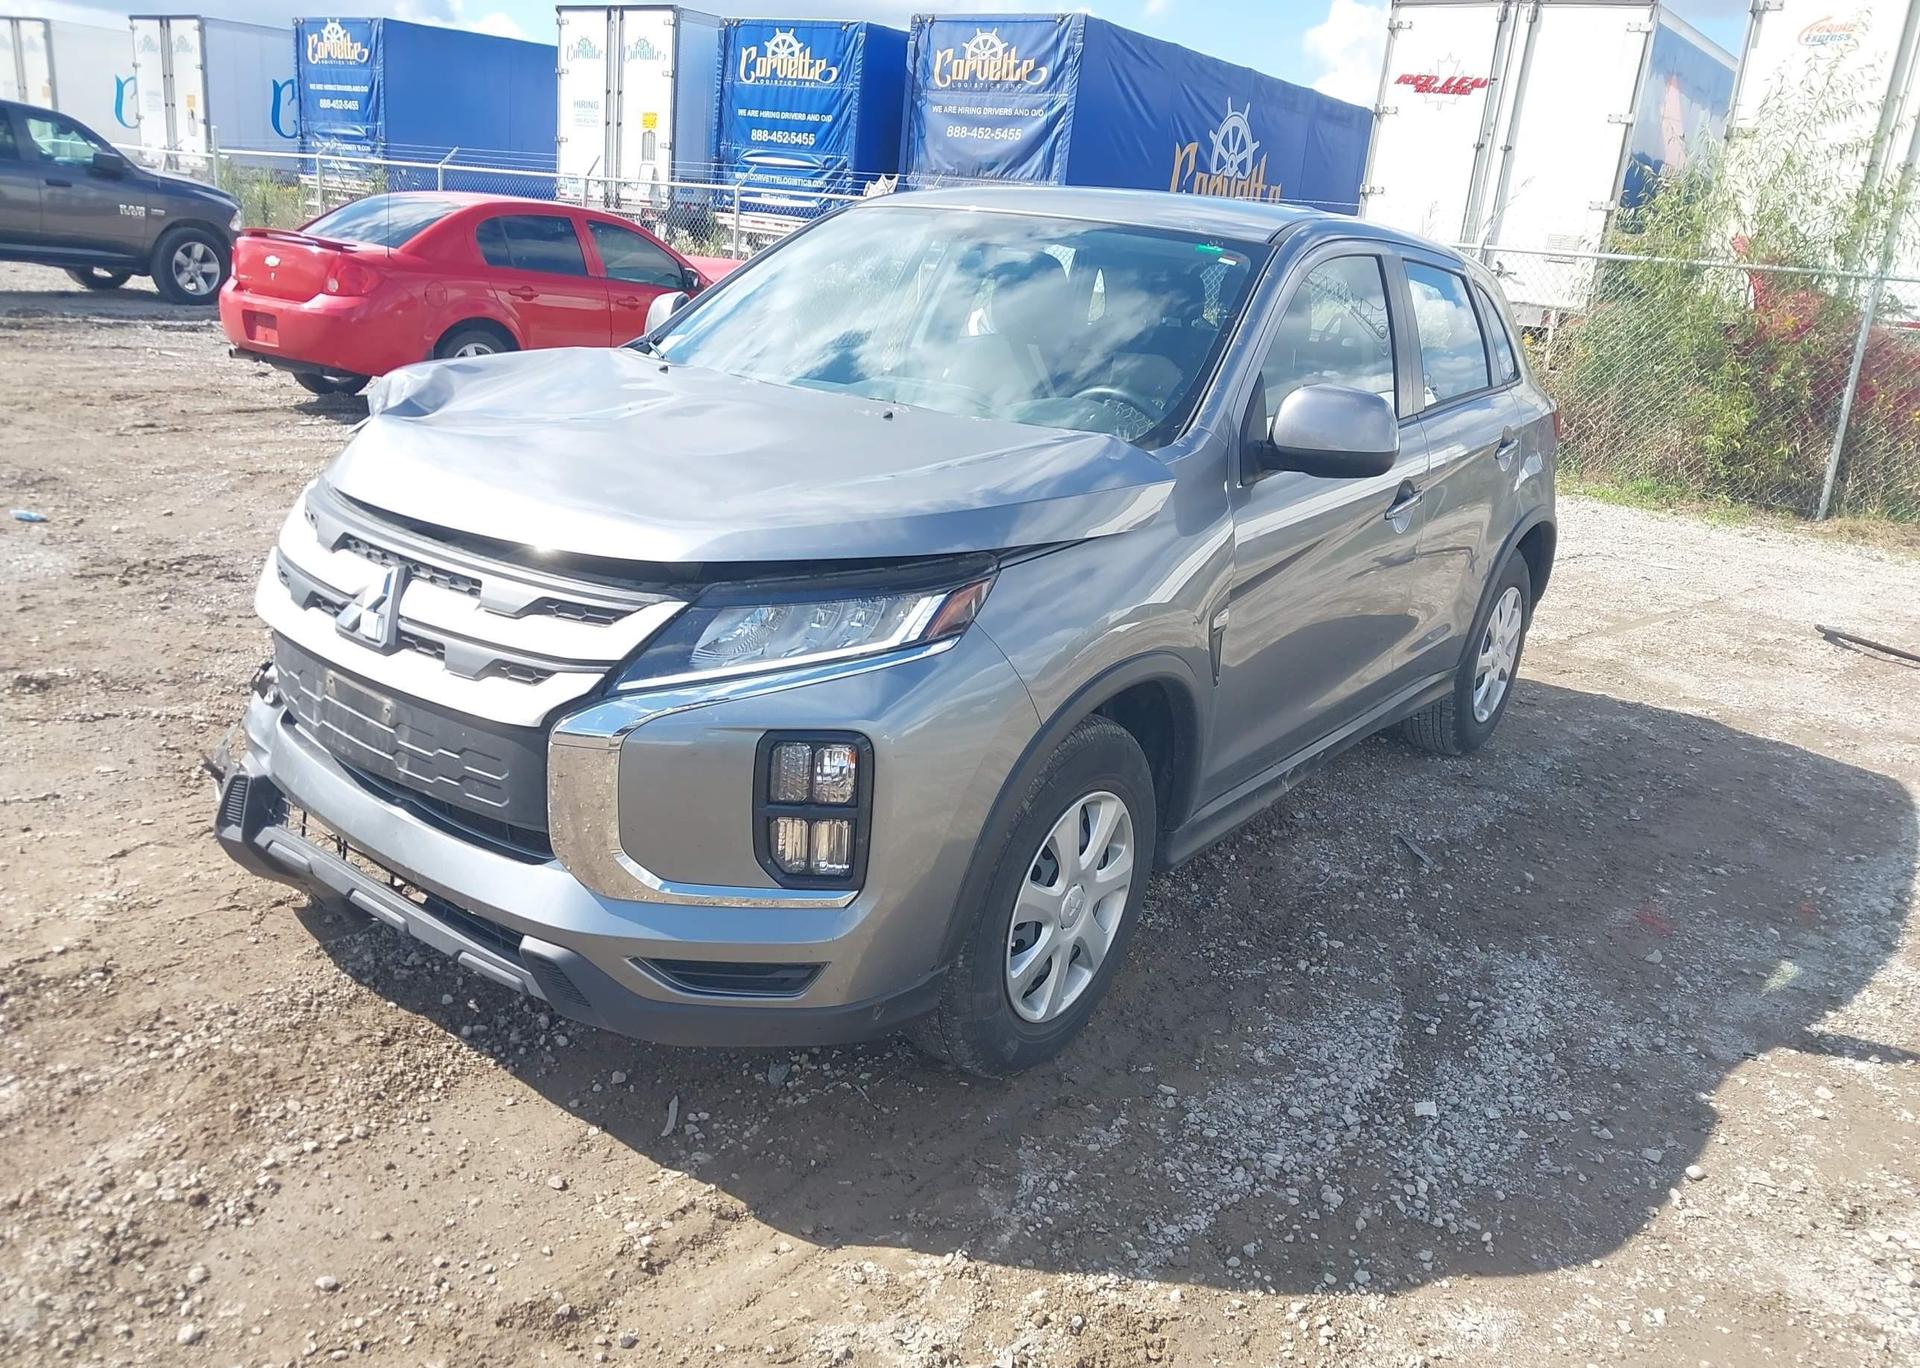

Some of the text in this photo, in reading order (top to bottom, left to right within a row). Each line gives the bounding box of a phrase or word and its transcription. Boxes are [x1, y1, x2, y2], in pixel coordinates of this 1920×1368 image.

[307, 32, 369, 65] Corvette
[740, 46, 838, 84] Corvette
[934, 46, 1048, 88] Corvette
[1394, 74, 1440, 85] RED
[737, 109, 748, 117] WE
[747, 109, 759, 118] ARE
[759, 110, 781, 120] HIRING
[780, 112, 806, 122] DRIVERS
[806, 114, 820, 122] AND
[932, 105, 943, 114] WE
[943, 105, 957, 114] ARE
[957, 106, 983, 116] HIRING
[982, 107, 1013, 116] DRIVERS
[1013, 108, 1030, 117] AND
[751, 129, 816, 145] 888-452-5455
[946, 126, 1023, 141] 888-452-5455
[119, 204, 145, 212] RAM
